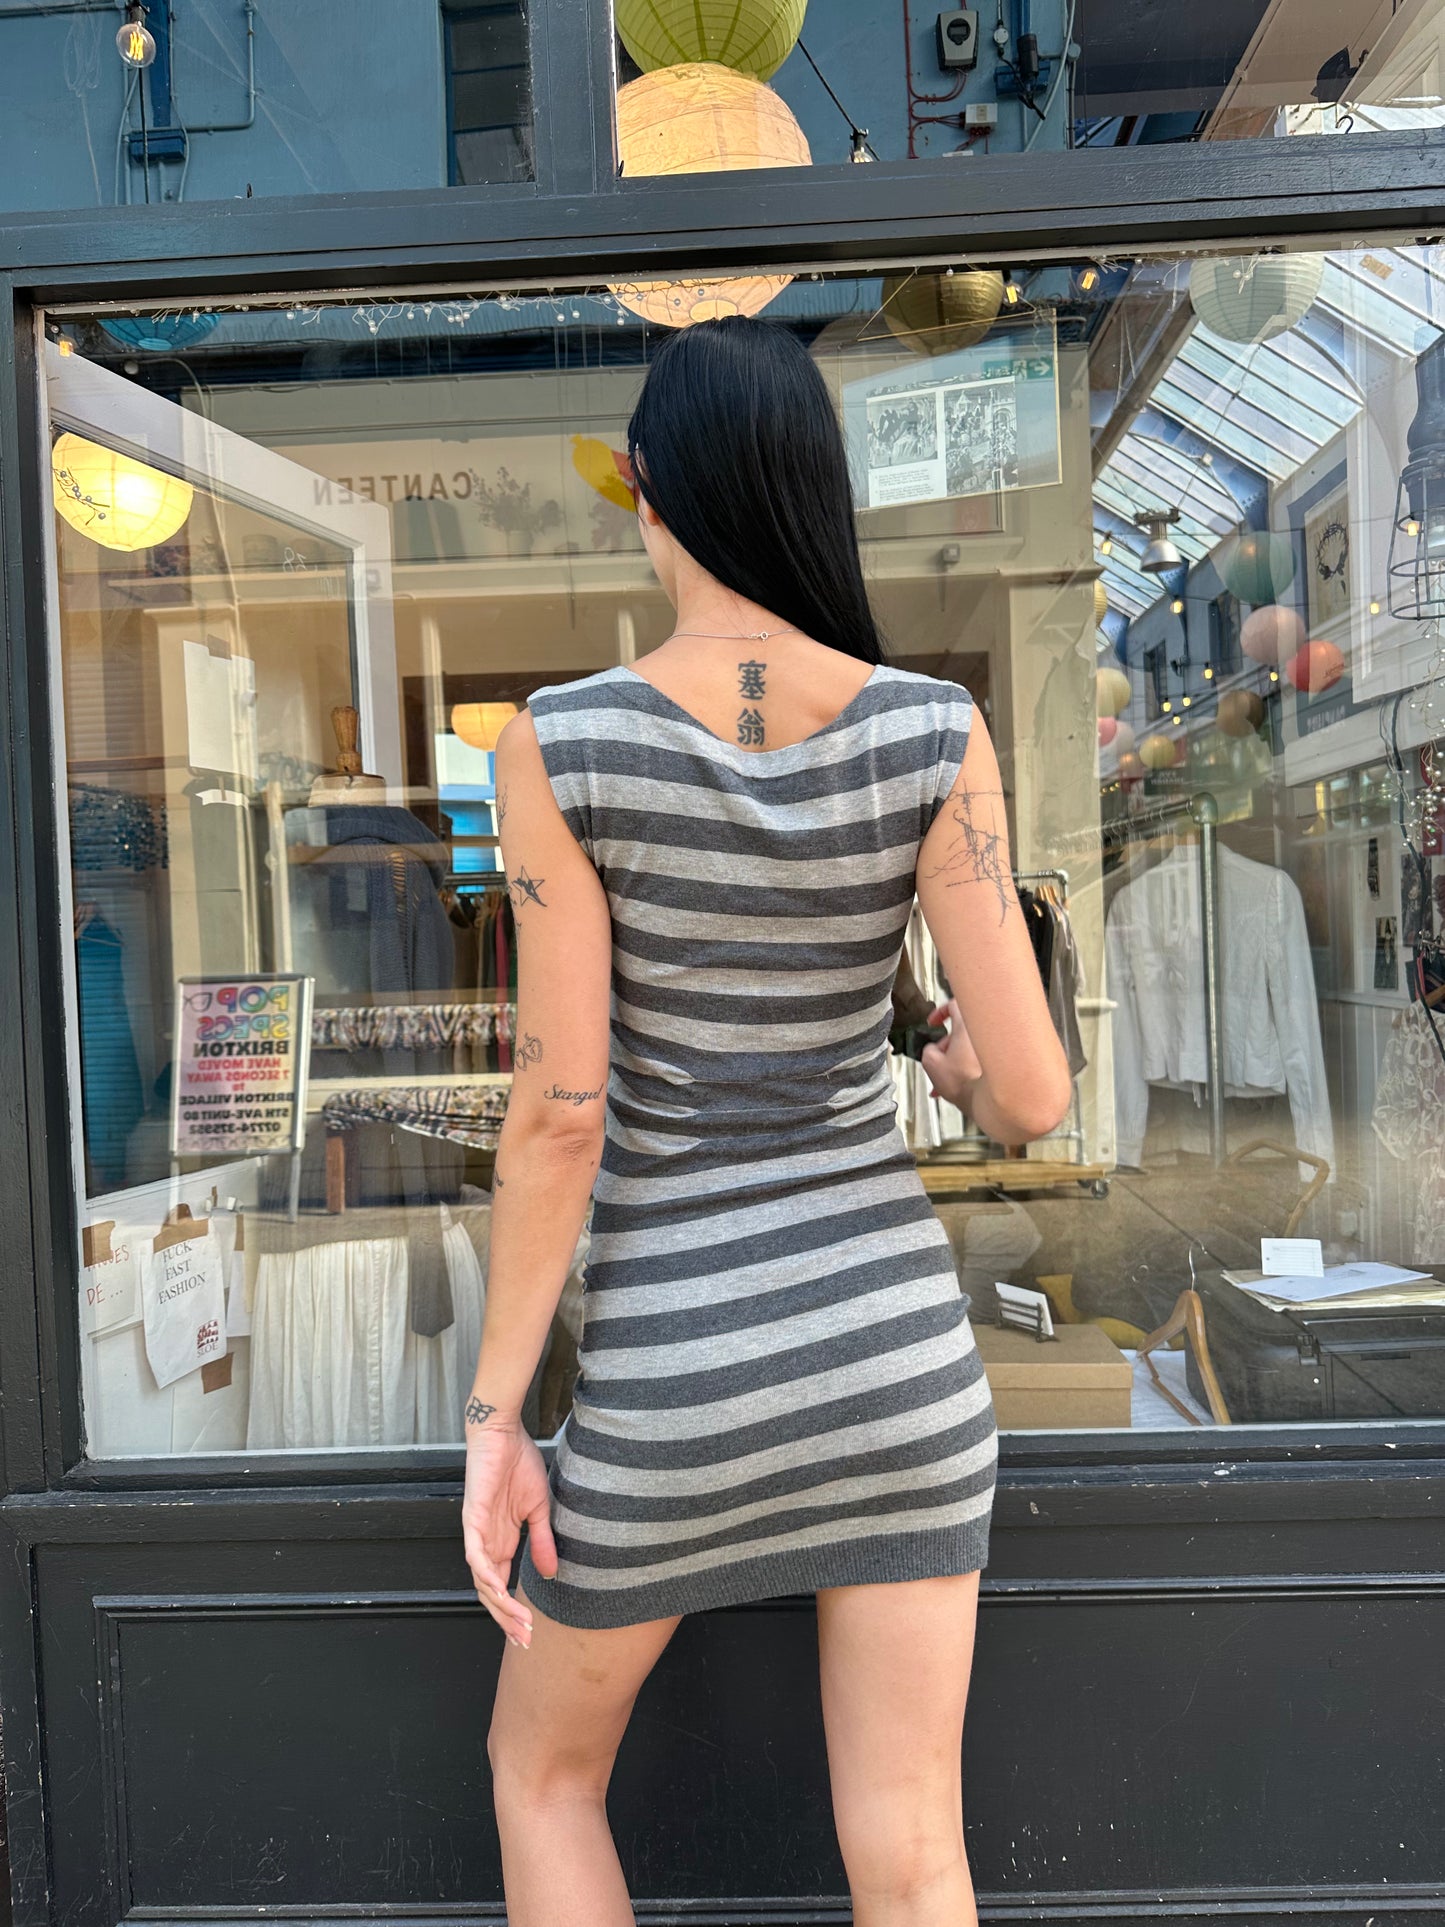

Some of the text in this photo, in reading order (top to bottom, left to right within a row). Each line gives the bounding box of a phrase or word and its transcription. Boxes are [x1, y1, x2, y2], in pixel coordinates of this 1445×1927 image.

[737, 659, 767, 746] 塞翁
[165, 1259, 192, 1281] FAST
[158, 1272, 206, 1305] FASHION
